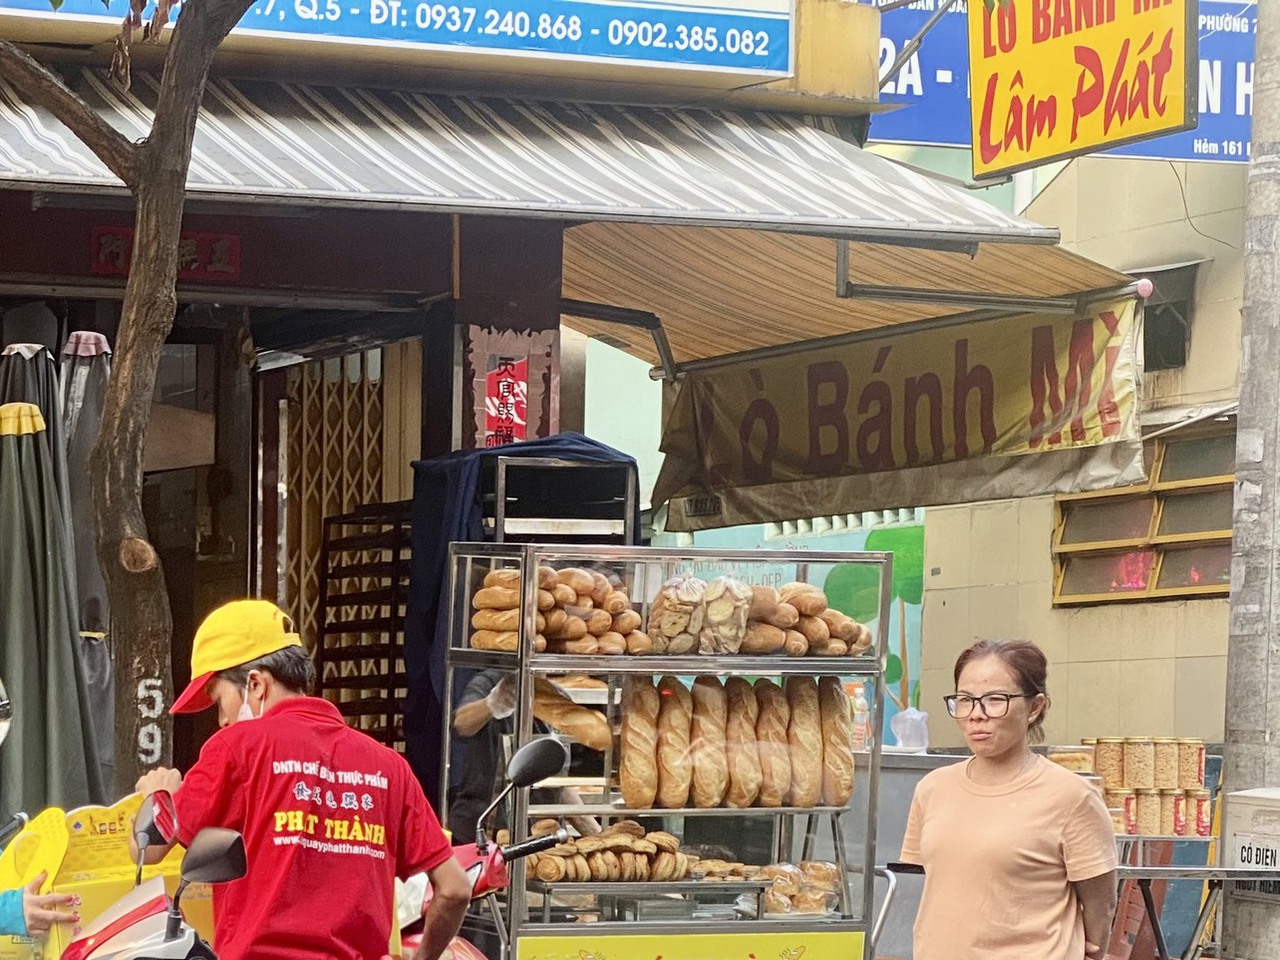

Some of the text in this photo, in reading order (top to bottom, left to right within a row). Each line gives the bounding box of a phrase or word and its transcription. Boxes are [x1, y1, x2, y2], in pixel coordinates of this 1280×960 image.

[415, 4, 582, 41] 0937.240.868
[608, 19, 769, 56] 0902.385.082
[1198, 13, 1249, 34] PHƯỜNG
[979, 26, 1174, 165] Lâm Phát
[1193, 138, 1243, 156] Hẻm 161
[806, 338, 997, 477] Bánh
[1028, 310, 1122, 449] Mì
[273, 760, 302, 775] DNTN
[336, 770, 363, 786] THỰC
[274, 811, 385, 845] PHT THÀNH
[1240, 842, 1253, 864] CÓ
